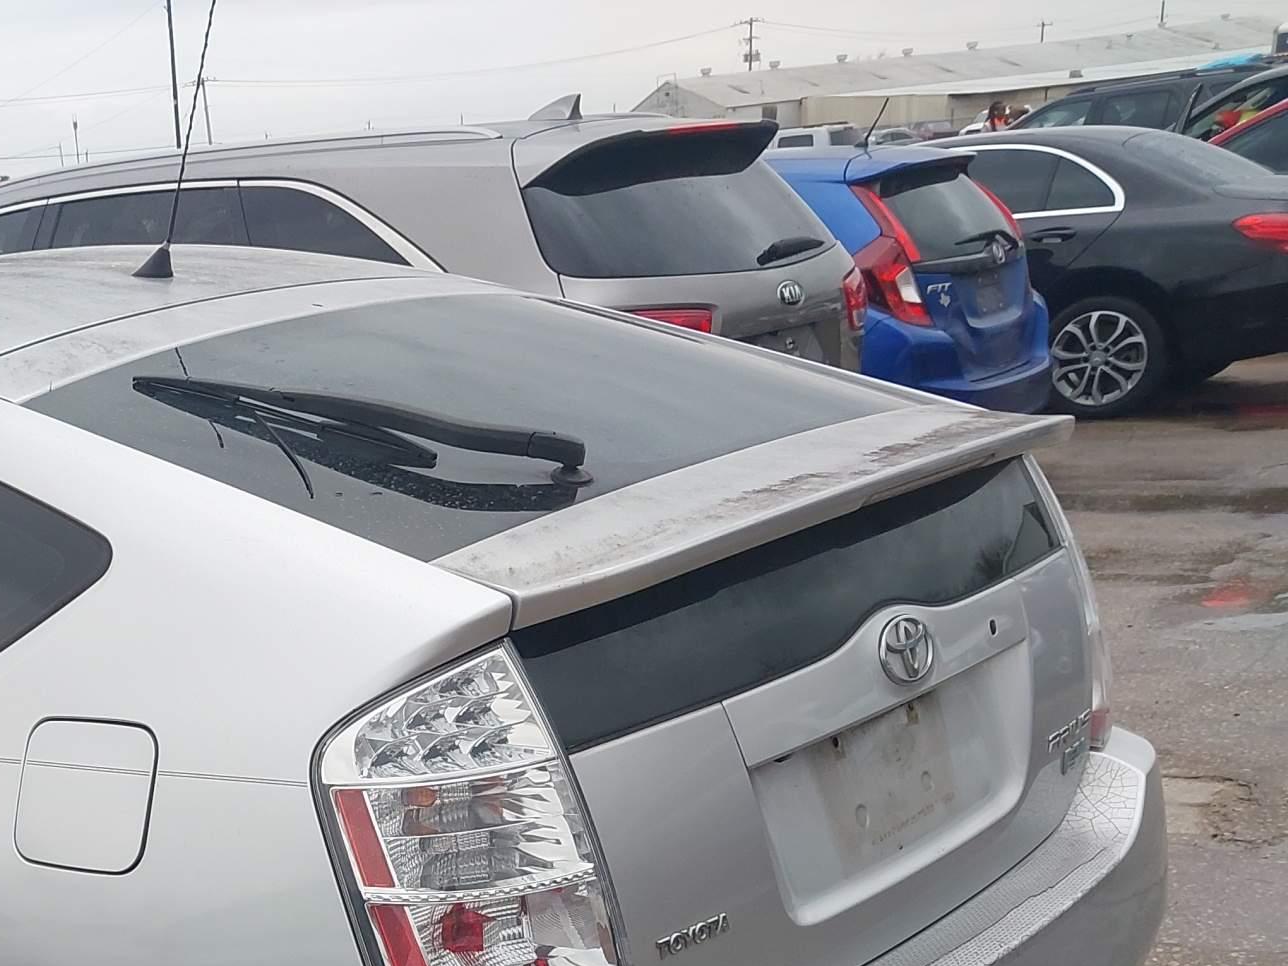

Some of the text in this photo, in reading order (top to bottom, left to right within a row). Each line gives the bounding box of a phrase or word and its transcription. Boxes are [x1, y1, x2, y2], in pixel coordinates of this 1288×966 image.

[781, 284, 802, 303] KIA
[926, 282, 952, 295] FIT
[656, 911, 730, 961] TOYOTA
